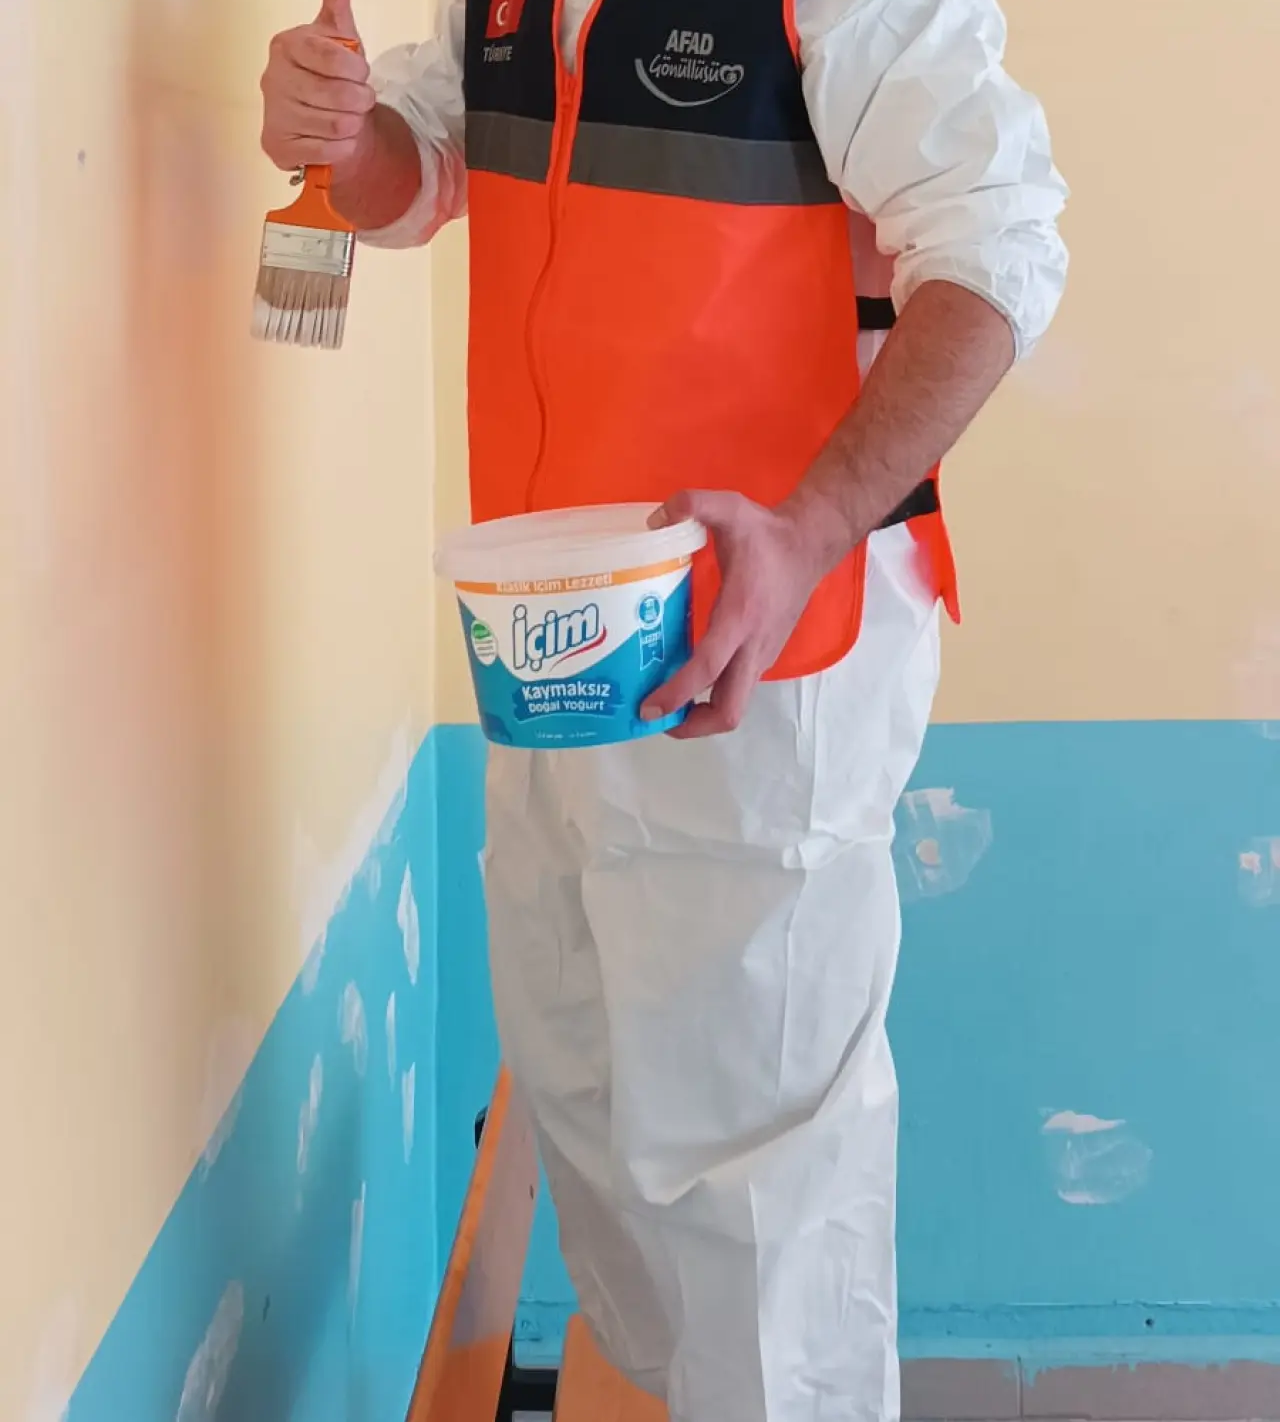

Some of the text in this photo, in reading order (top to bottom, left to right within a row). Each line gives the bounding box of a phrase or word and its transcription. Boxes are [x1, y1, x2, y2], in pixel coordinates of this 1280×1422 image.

[665, 29, 715, 56] AFAD
[649, 54, 720, 83] Gönüllüsü
[521, 680, 611, 701] Kaymaksız
